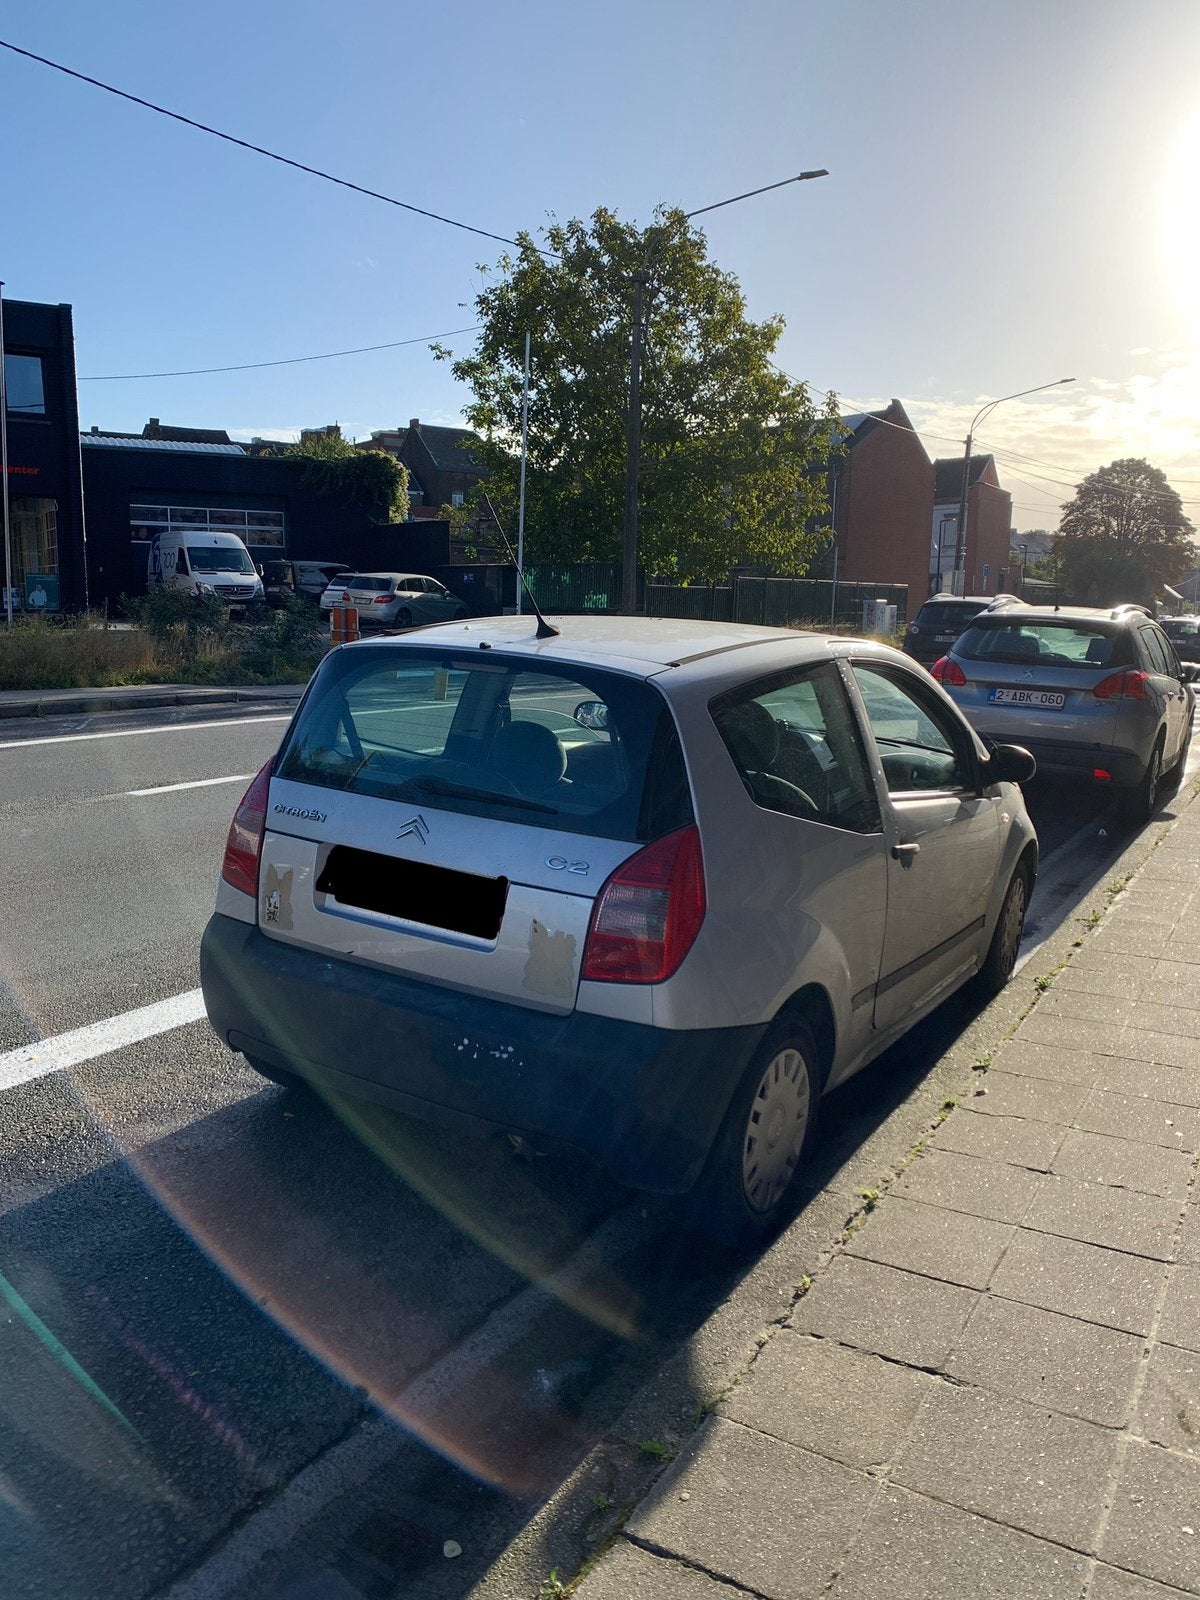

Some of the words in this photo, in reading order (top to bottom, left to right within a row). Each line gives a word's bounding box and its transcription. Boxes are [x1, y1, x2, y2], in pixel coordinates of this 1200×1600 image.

[996, 690, 1064, 705] 2-ABK-060
[273, 803, 327, 823] CITROËN
[544, 855, 590, 876] C2
